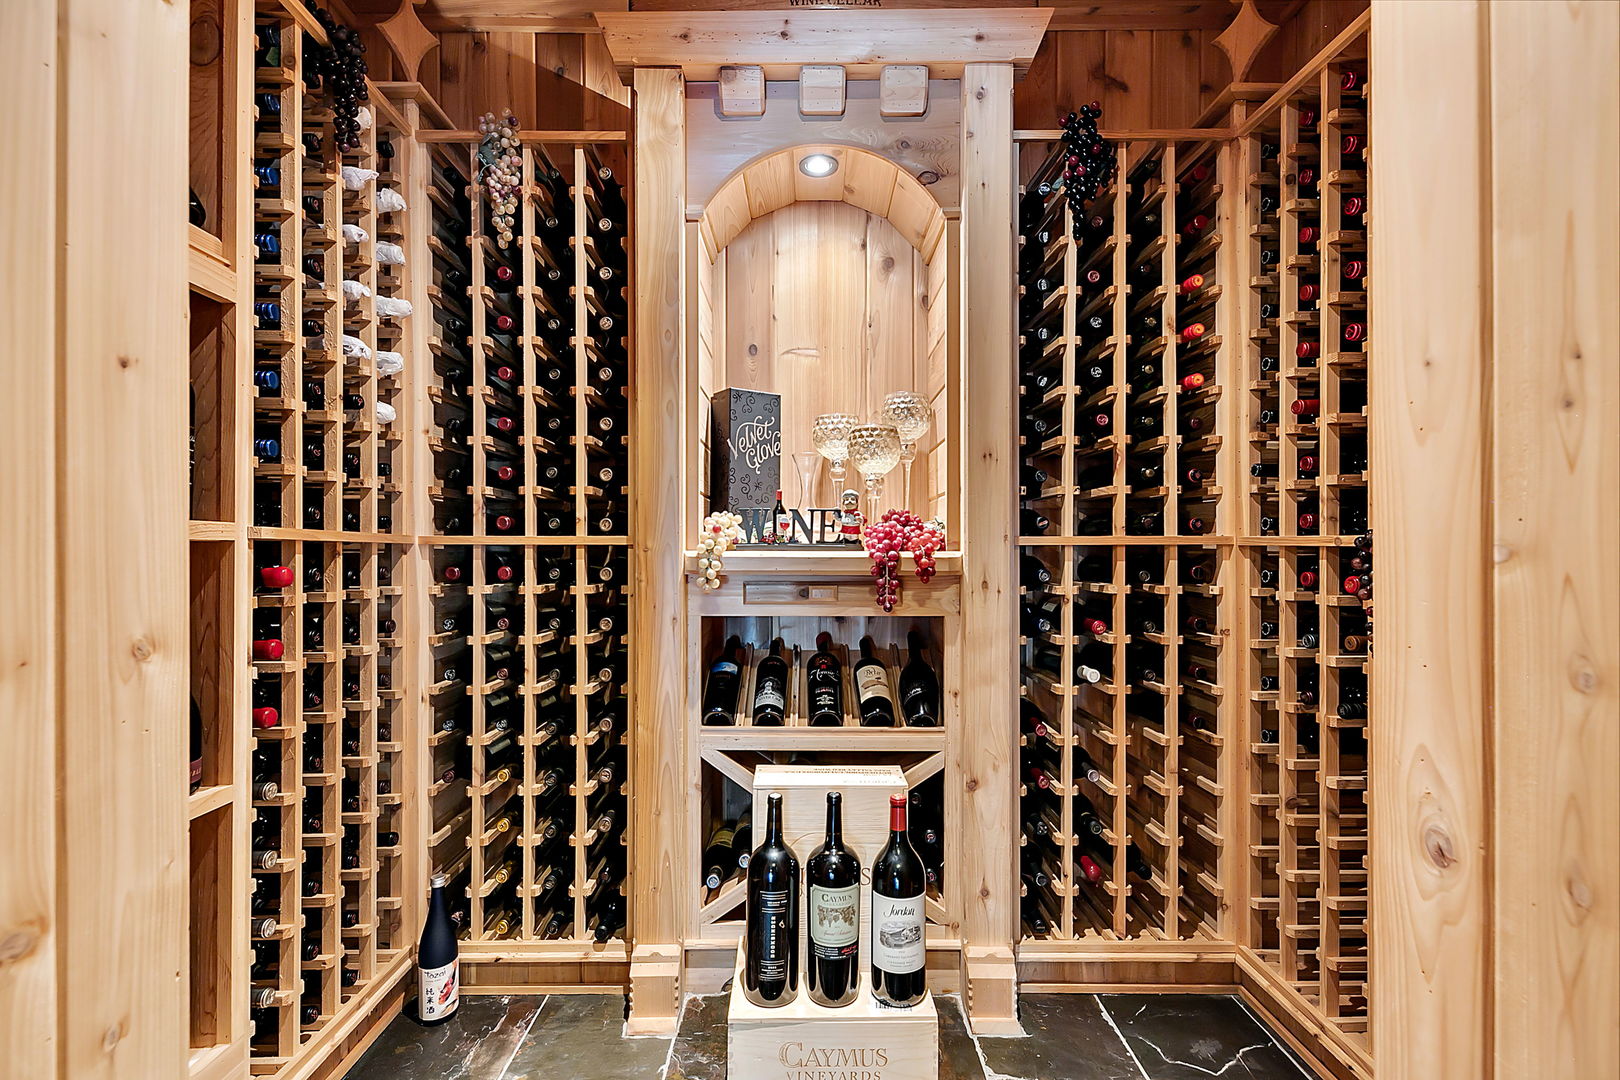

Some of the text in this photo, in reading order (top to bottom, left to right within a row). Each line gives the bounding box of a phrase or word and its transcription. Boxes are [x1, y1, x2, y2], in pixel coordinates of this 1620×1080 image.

[727, 416, 775, 460] Velvet
[746, 431, 781, 475] Glove
[821, 893, 853, 902] CAYMUS
[883, 904, 916, 918] Jordan
[778, 1041, 889, 1068] CAYMUS
[786, 1071, 881, 1080] VINEYARDS
